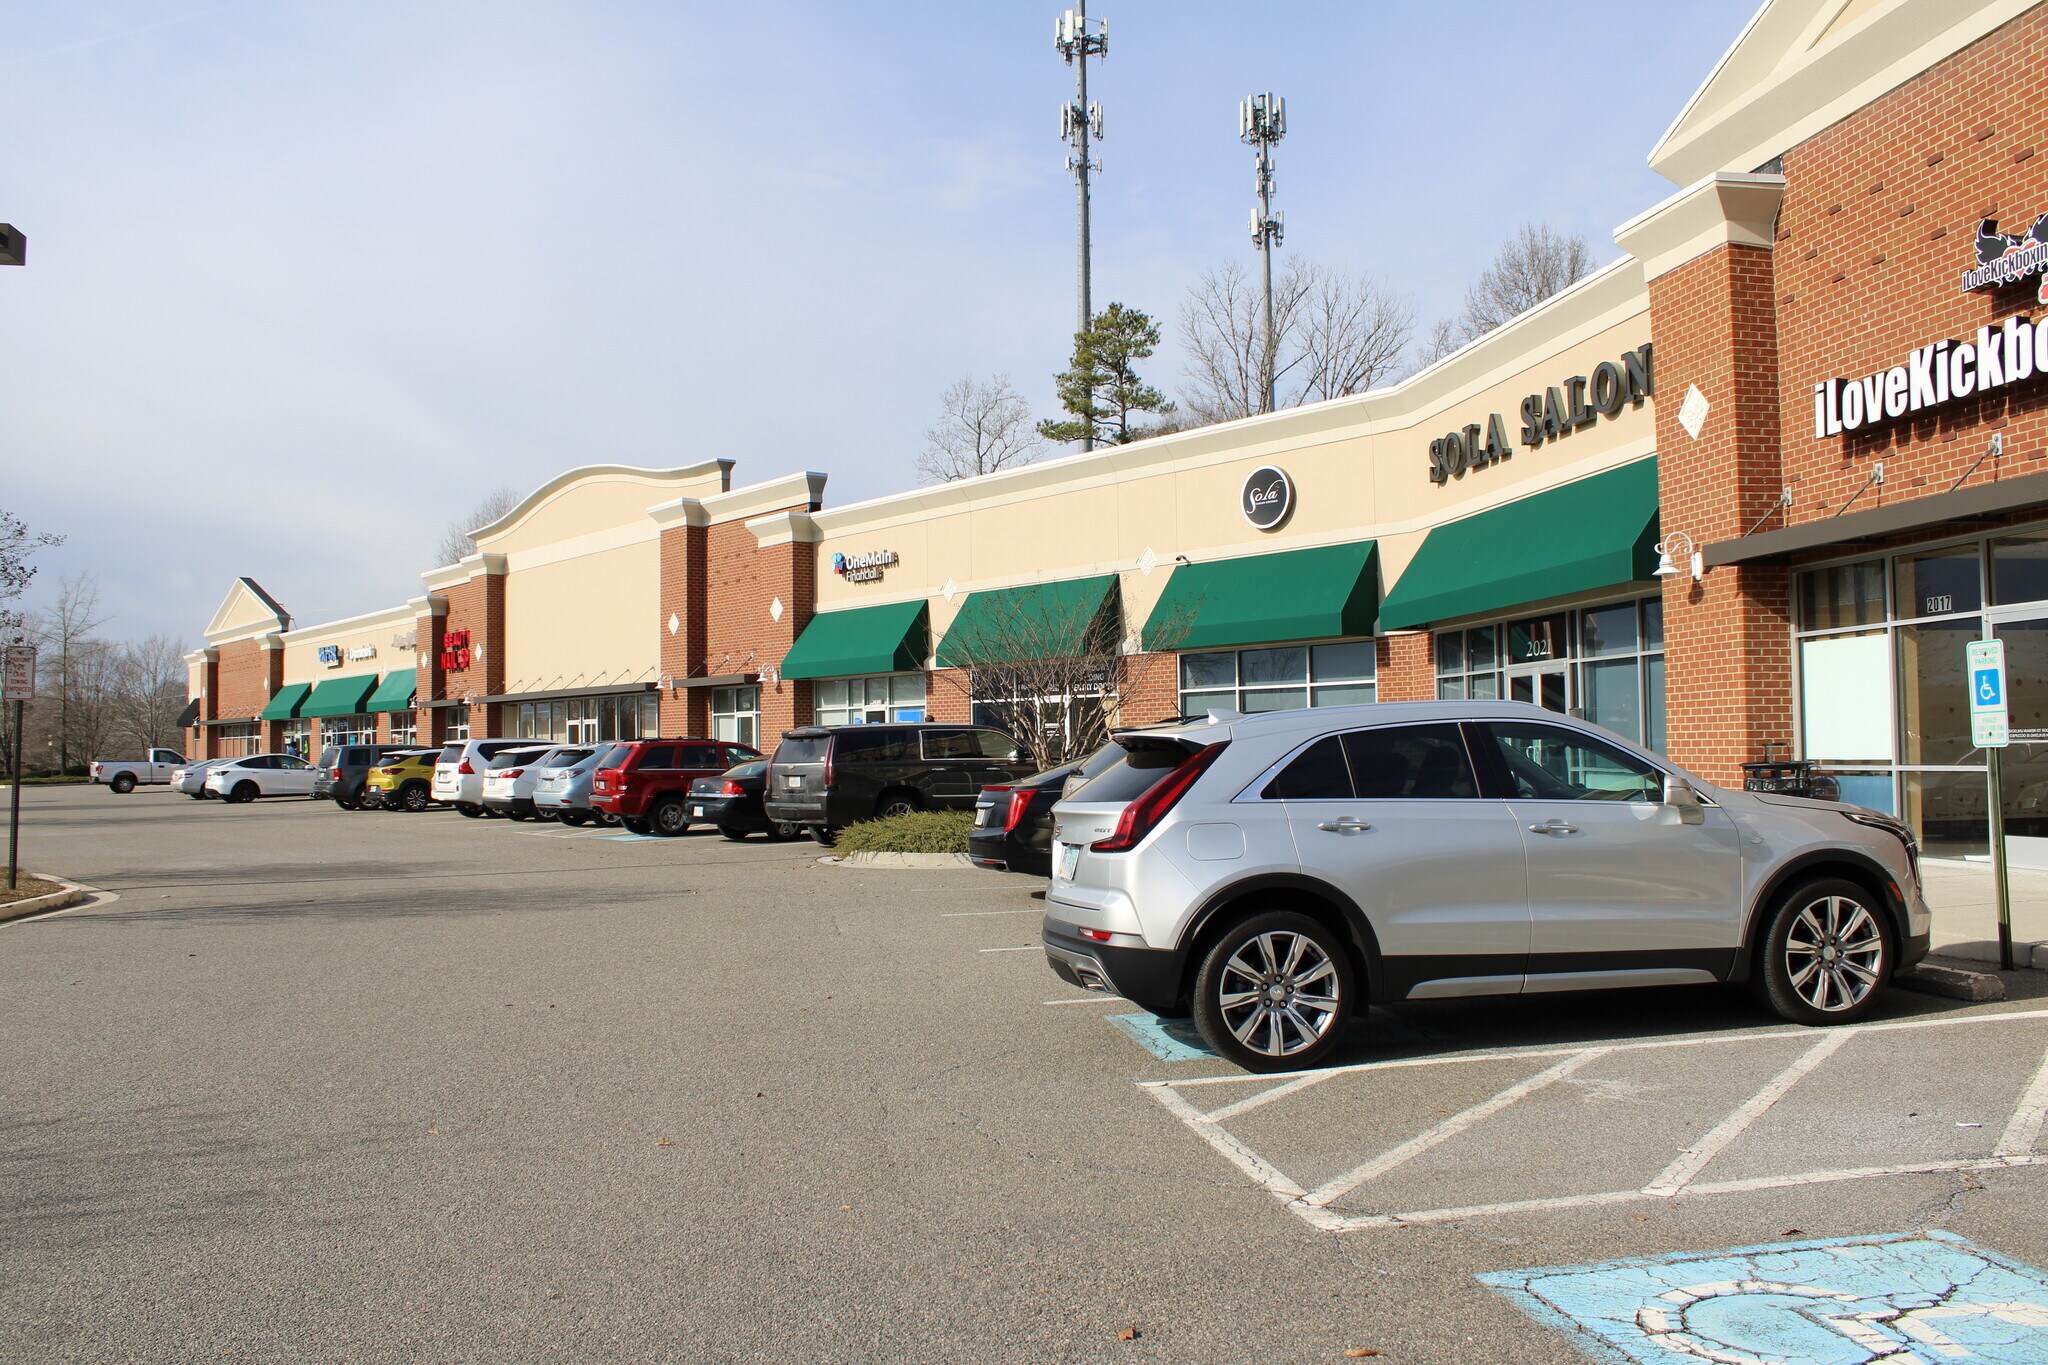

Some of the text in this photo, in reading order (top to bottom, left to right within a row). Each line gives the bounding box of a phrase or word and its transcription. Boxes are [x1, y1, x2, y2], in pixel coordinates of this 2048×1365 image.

[1429, 342, 1653, 483] SOLA SALON
[1246, 479, 1284, 514] Sola
[846, 550, 892, 570] OneMain
[846, 566, 878, 582] Financial
[1927, 595, 1951, 612] 2017
[443, 630, 470, 648] BEAUTY
[1526, 639, 1552, 657] 2021
[1971, 647, 1999, 656] RESERVED
[1975, 657, 1997, 665] PARKING
